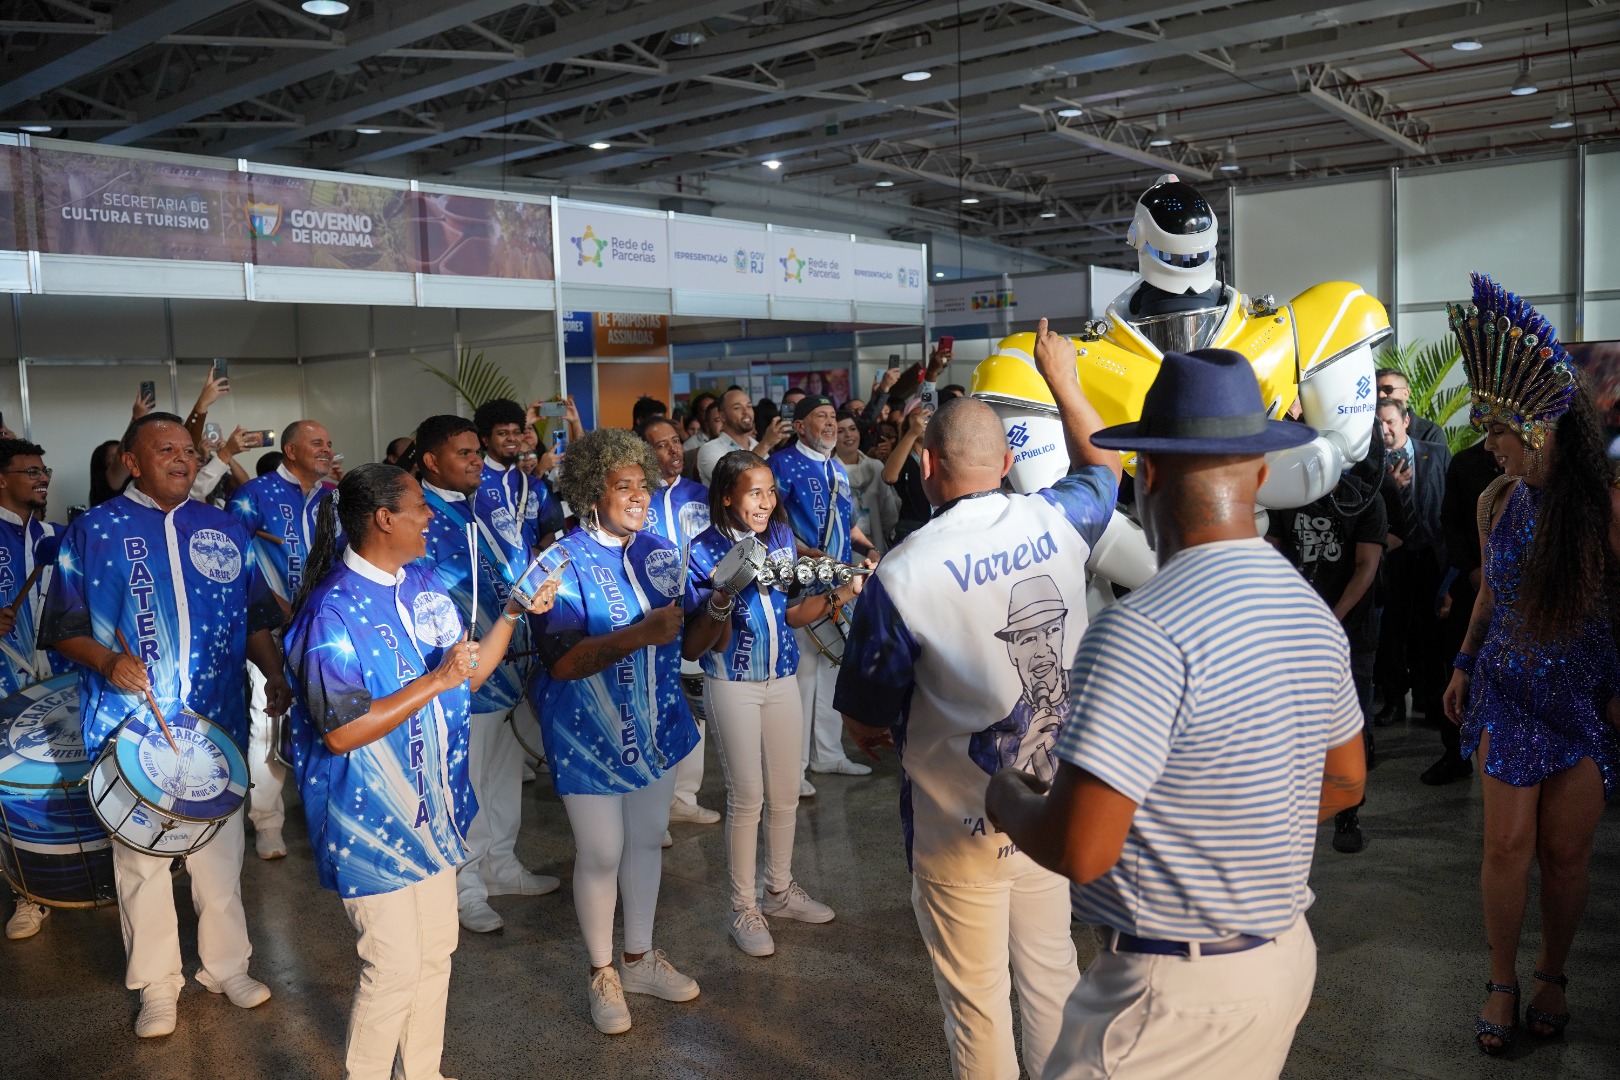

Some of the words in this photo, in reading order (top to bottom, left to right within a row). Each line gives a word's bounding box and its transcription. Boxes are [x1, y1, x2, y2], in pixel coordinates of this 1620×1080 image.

[102, 192, 188, 212] SECRETARIA
[190, 201, 209, 214] DE
[61, 206, 131, 224] CULTURA
[134, 212, 143, 225] E
[145, 213, 210, 230] TURISMO
[290, 209, 373, 233] GOVERNO
[291, 228, 311, 243] DE
[312, 230, 374, 248] RORAIMA
[611, 236, 639, 250] Rede
[640, 239, 655, 252] de
[611, 248, 657, 263] Parcerias
[750, 251, 765, 261] GOV
[808, 257, 828, 269] Rede
[829, 260, 839, 270] de
[750, 260, 764, 274] RJ
[808, 267, 840, 280] Parcerias
[908, 276, 919, 288] RJ
[971, 291, 1018, 311] BRASIL
[598, 312, 611, 327] DE
[612, 313, 661, 329] PROPOSTAS
[607, 329, 654, 345] ASSINADAS
[1021, 443, 1056, 461] PÚBLICO
[193, 530, 231, 543] BATERIA
[374, 623, 430, 829] BAERIA
[619, 703, 640, 767] LEO
[191, 783, 219, 798] ARUC-DF
